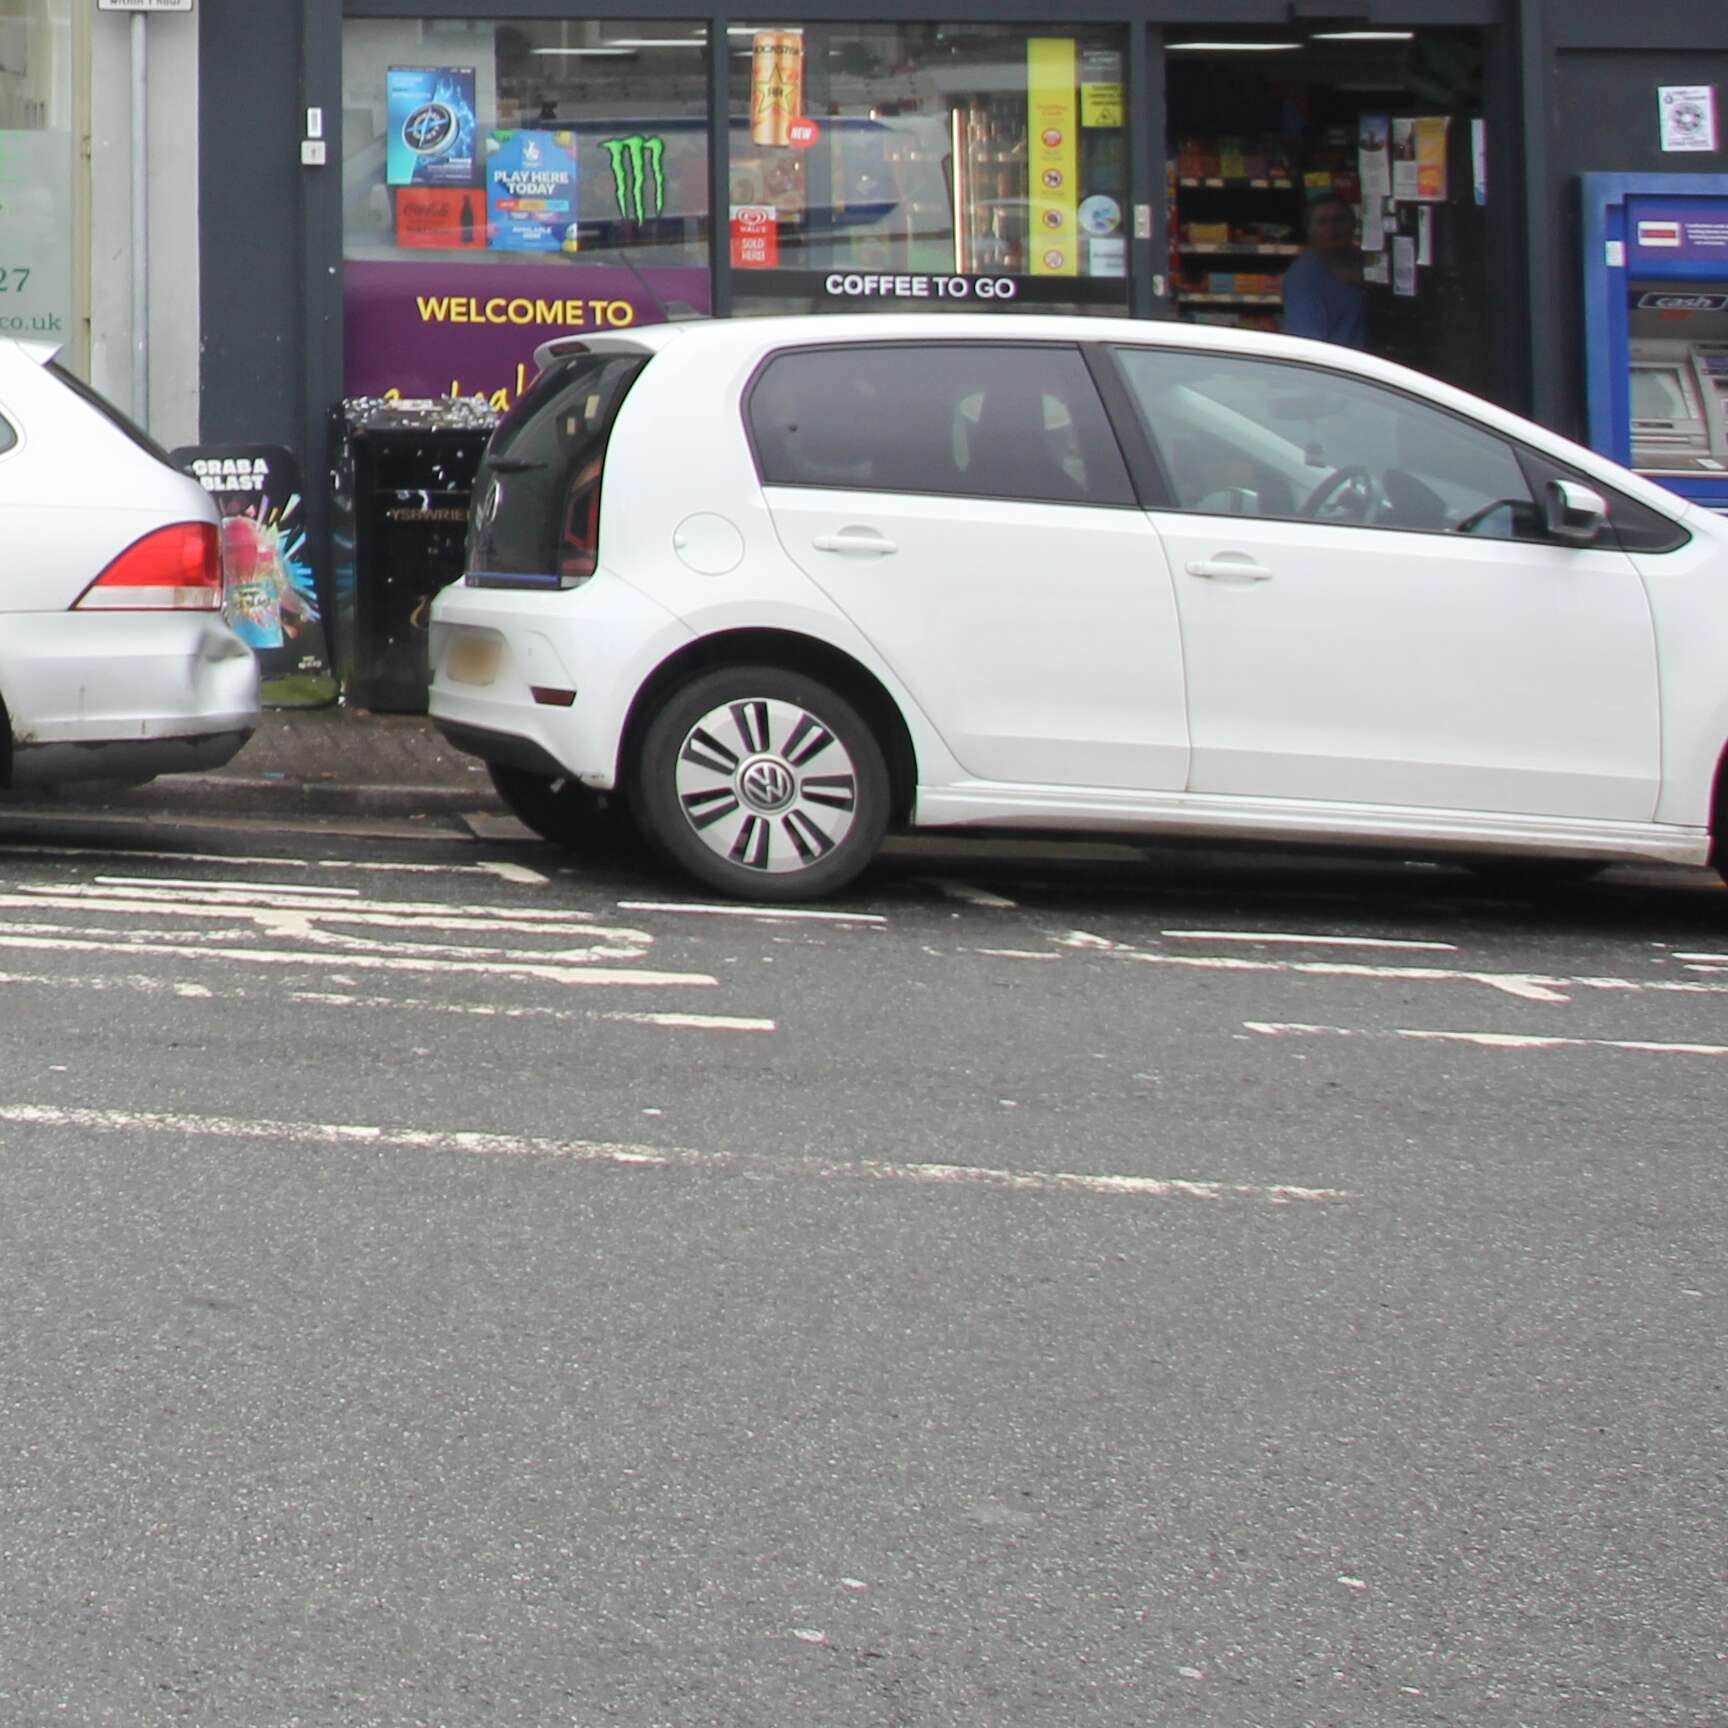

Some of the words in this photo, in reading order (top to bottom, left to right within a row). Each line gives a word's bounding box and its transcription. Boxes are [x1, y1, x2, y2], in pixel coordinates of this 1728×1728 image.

[790, 127, 812, 140] NEW
[493, 170, 530, 183] PLAY
[530, 170, 569, 184] HERE
[508, 182, 556, 195] TODAY
[825, 274, 929, 297] COFFEE
[932, 276, 968, 298] TO
[974, 277, 1016, 298] GO
[1655, 295, 1713, 308] cash
[416, 295, 585, 325] WELCOME
[588, 300, 634, 327] TO
[199, 475, 265, 491] BLAST
